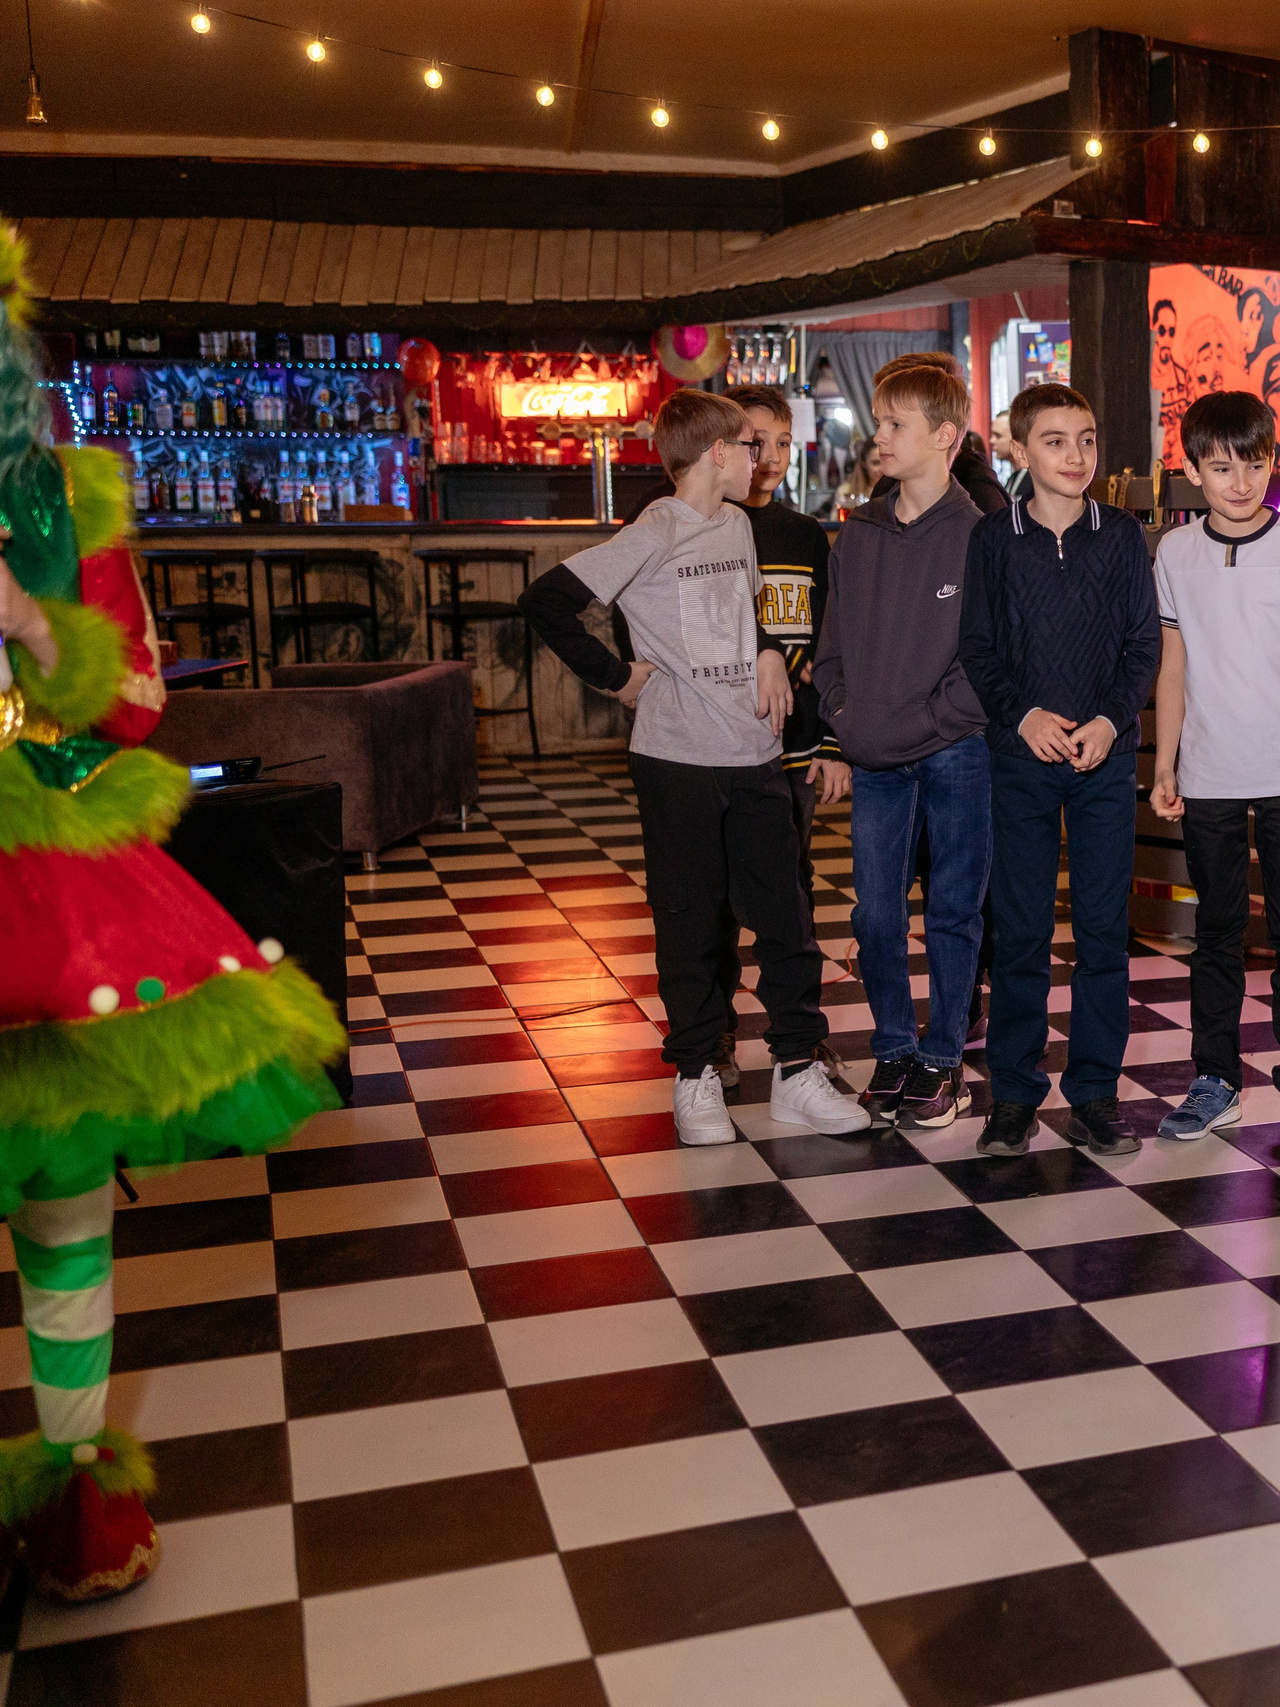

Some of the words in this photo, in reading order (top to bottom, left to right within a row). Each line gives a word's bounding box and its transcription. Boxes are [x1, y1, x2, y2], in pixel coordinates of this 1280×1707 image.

[677, 558, 749, 578] SKATEBOARDING
[759, 583, 811, 626] REA
[692, 661, 753, 679] FREESTY
